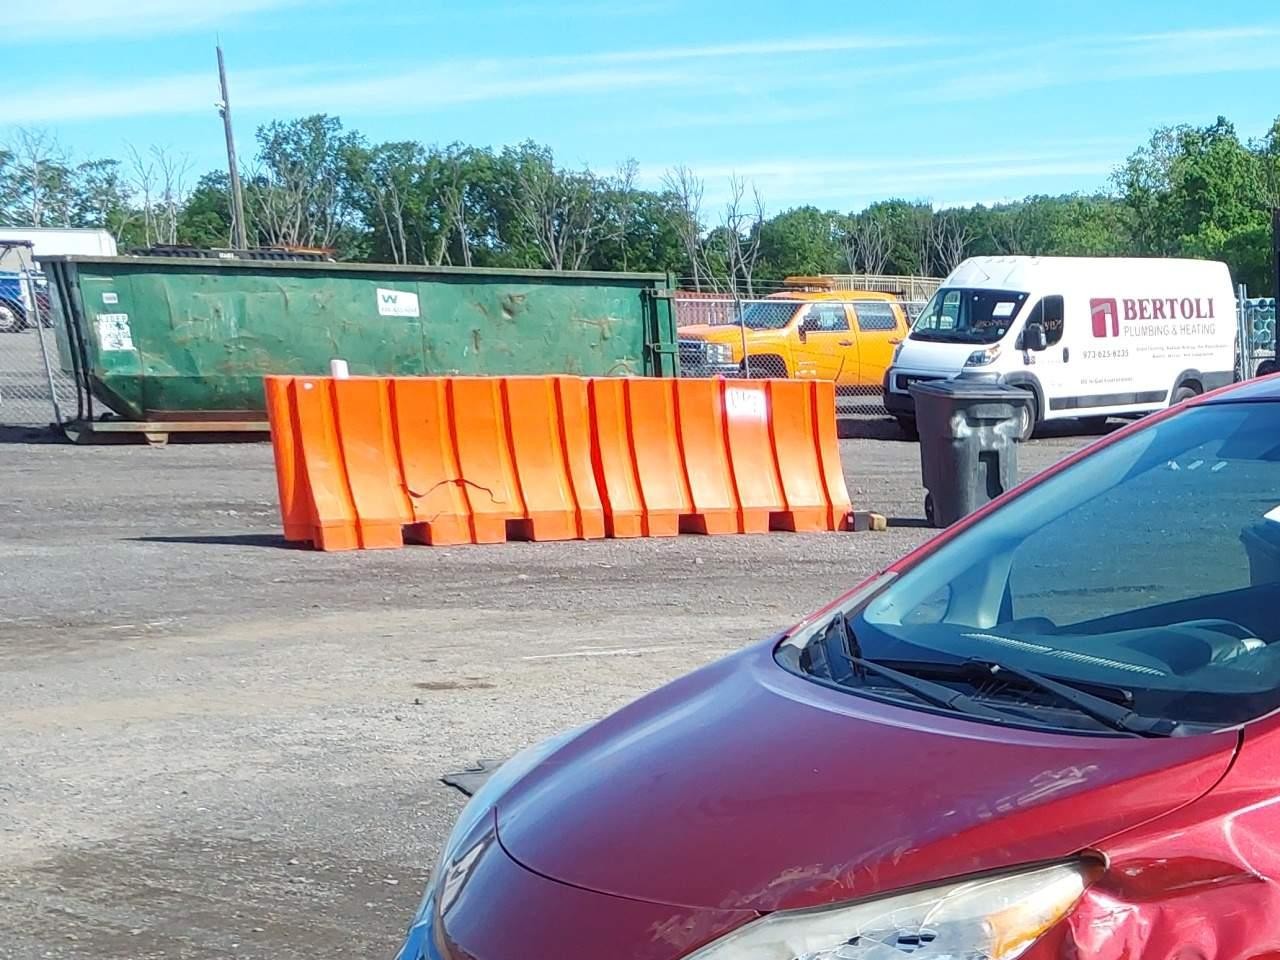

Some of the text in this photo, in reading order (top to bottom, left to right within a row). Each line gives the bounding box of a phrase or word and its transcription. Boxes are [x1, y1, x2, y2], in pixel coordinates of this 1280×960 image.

[1123, 297, 1215, 321] BERTOLI
[1124, 323, 1216, 337] PLUMBING & HEATING
